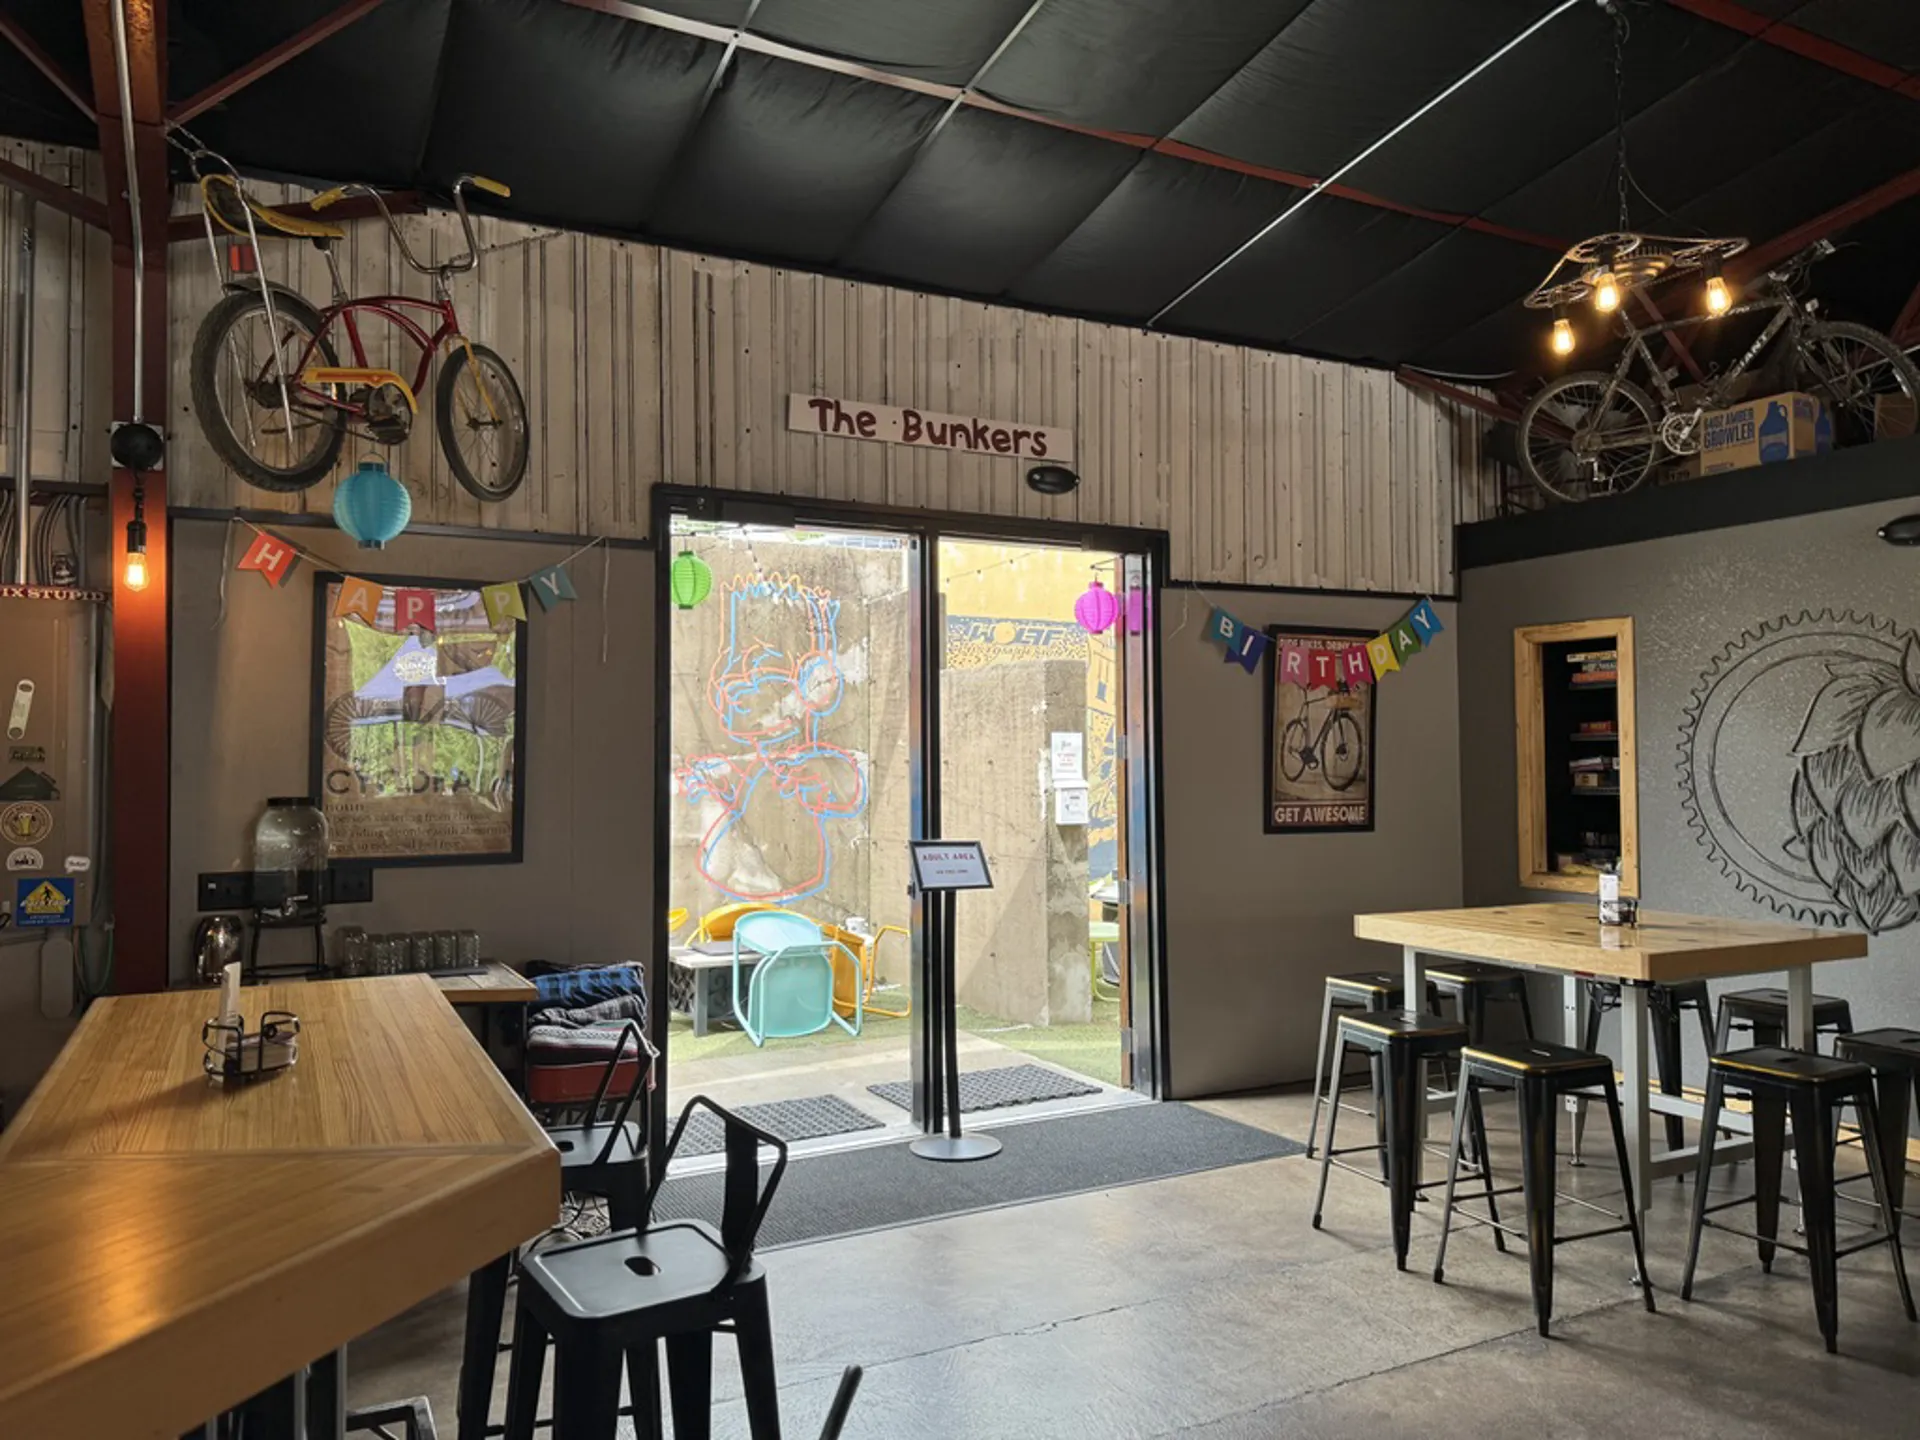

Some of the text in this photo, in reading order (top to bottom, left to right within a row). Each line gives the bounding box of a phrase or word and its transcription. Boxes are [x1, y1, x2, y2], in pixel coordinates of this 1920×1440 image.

[808, 399, 1048, 457] The Bunkers
[1704, 421, 1755, 449] GROWLER
[27, 588, 105, 601] STUPID
[1274, 805, 1366, 822] GET AWESOME
